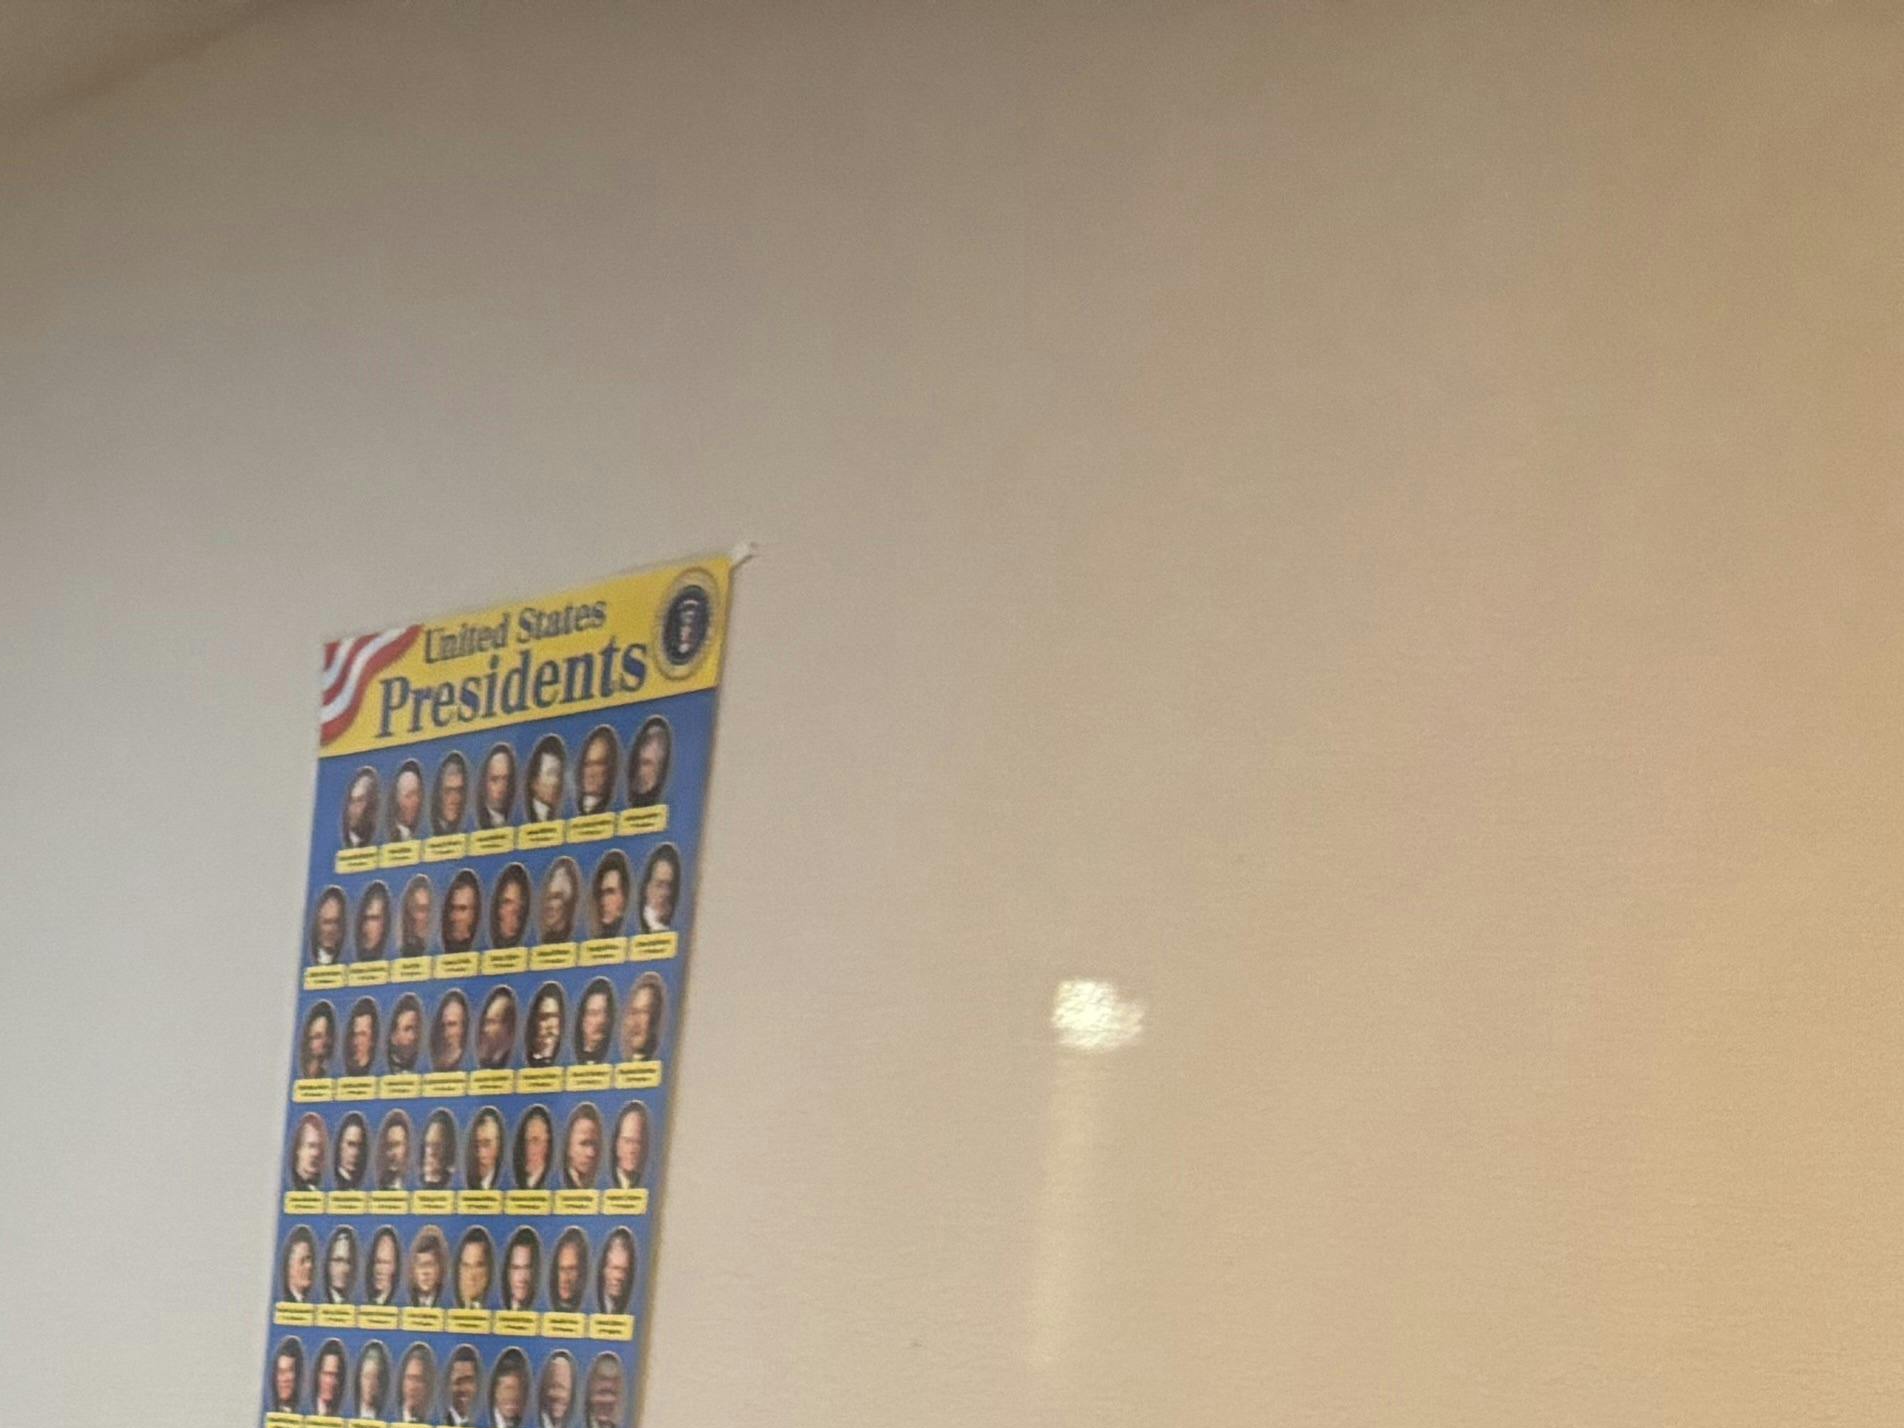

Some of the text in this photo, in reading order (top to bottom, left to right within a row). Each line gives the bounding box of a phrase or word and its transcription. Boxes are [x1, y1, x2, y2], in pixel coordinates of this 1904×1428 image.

[424, 614, 510, 664] United
[515, 599, 608, 644] States
[377, 641, 649, 740] Presidents
